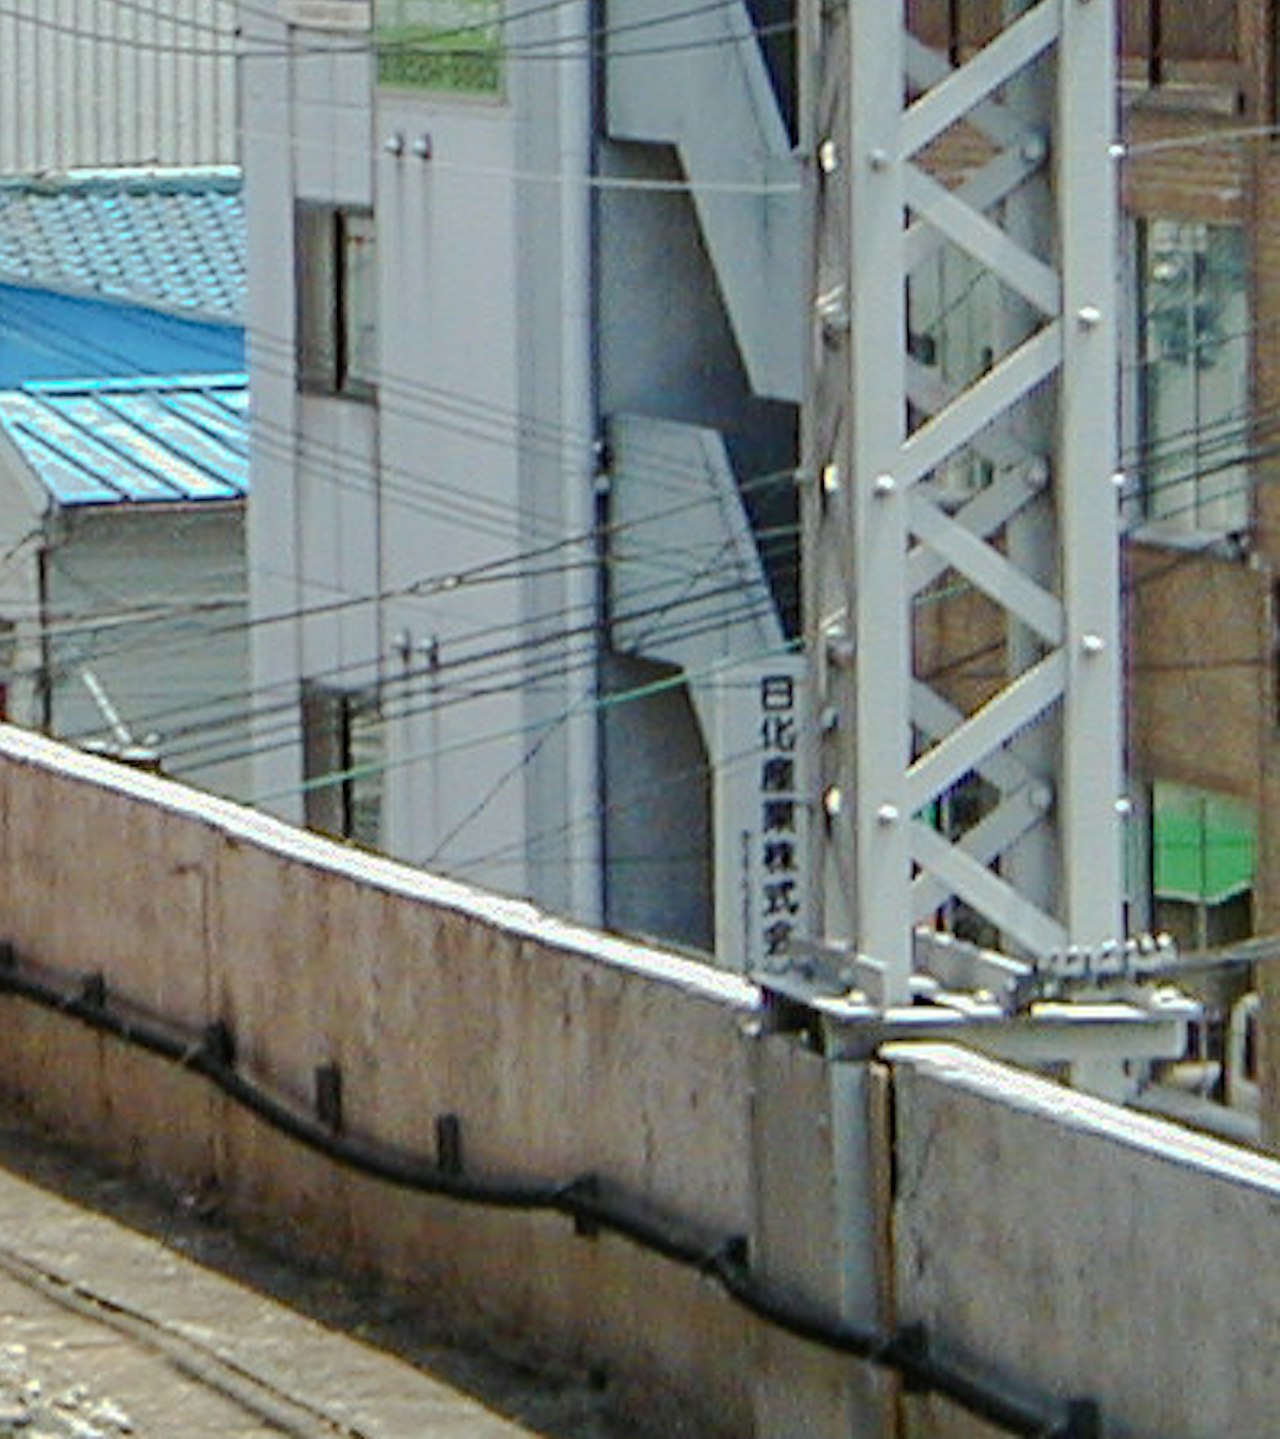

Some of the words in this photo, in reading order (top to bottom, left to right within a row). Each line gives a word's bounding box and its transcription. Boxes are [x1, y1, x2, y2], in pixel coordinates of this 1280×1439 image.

[760, 674, 798, 974] 日化産業株式会
